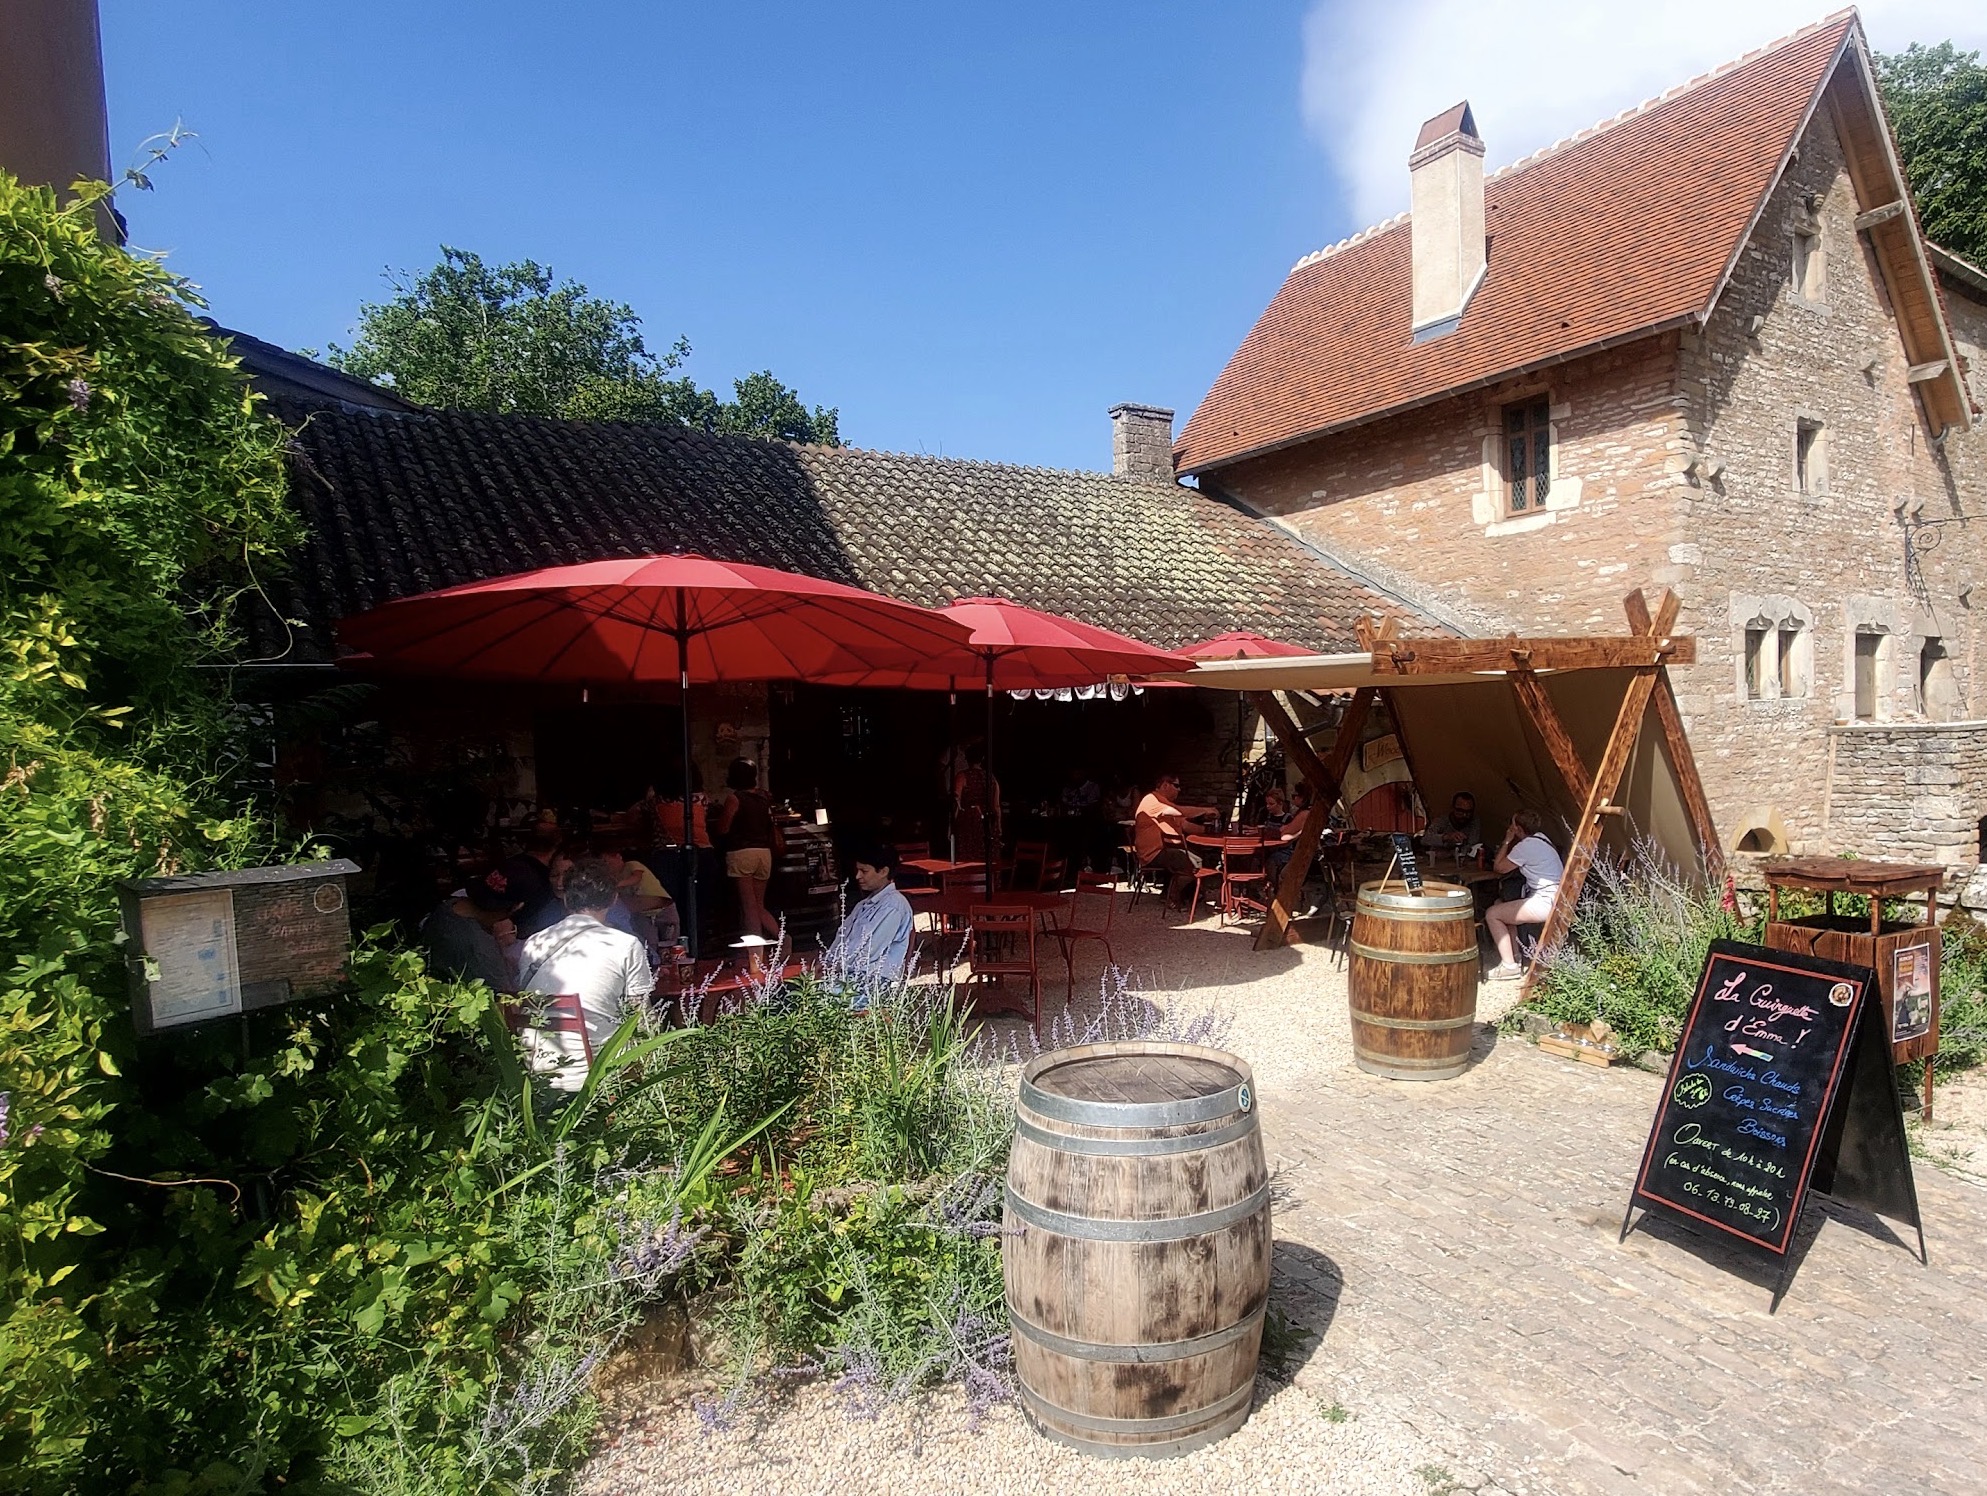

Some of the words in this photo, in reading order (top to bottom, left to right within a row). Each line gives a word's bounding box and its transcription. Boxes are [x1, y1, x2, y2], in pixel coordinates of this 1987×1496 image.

[1714, 972, 1746, 1002] La
[1760, 1071, 1801, 1094] Chauds
[1737, 1118, 1786, 1147] Boissons
[1721, 1148, 1732, 1158] de
